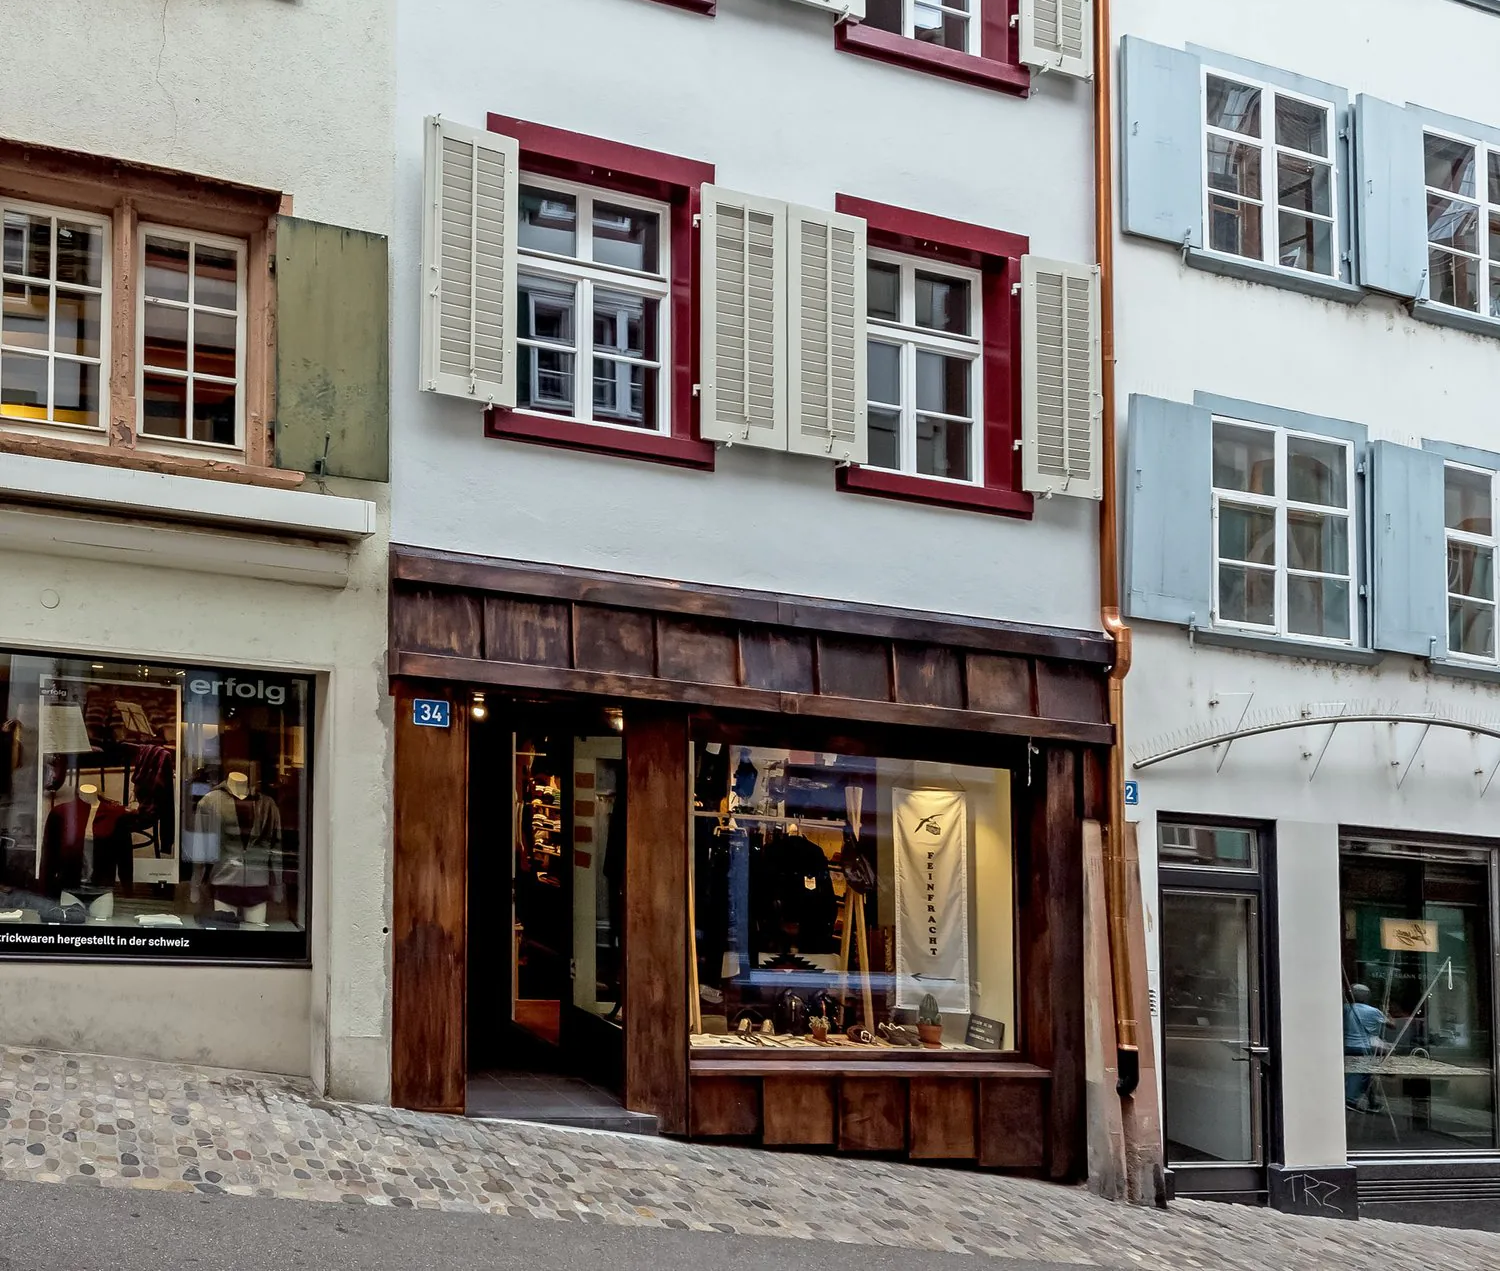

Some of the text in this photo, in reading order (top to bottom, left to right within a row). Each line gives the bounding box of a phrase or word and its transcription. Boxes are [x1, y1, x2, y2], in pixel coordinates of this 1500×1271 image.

[190, 678, 285, 705] erfolg
[421, 704, 442, 722] 34
[926, 851, 938, 956] FEINFRACHT
[0, 932, 190, 947] rickwaren hergestellt in der schweiz
